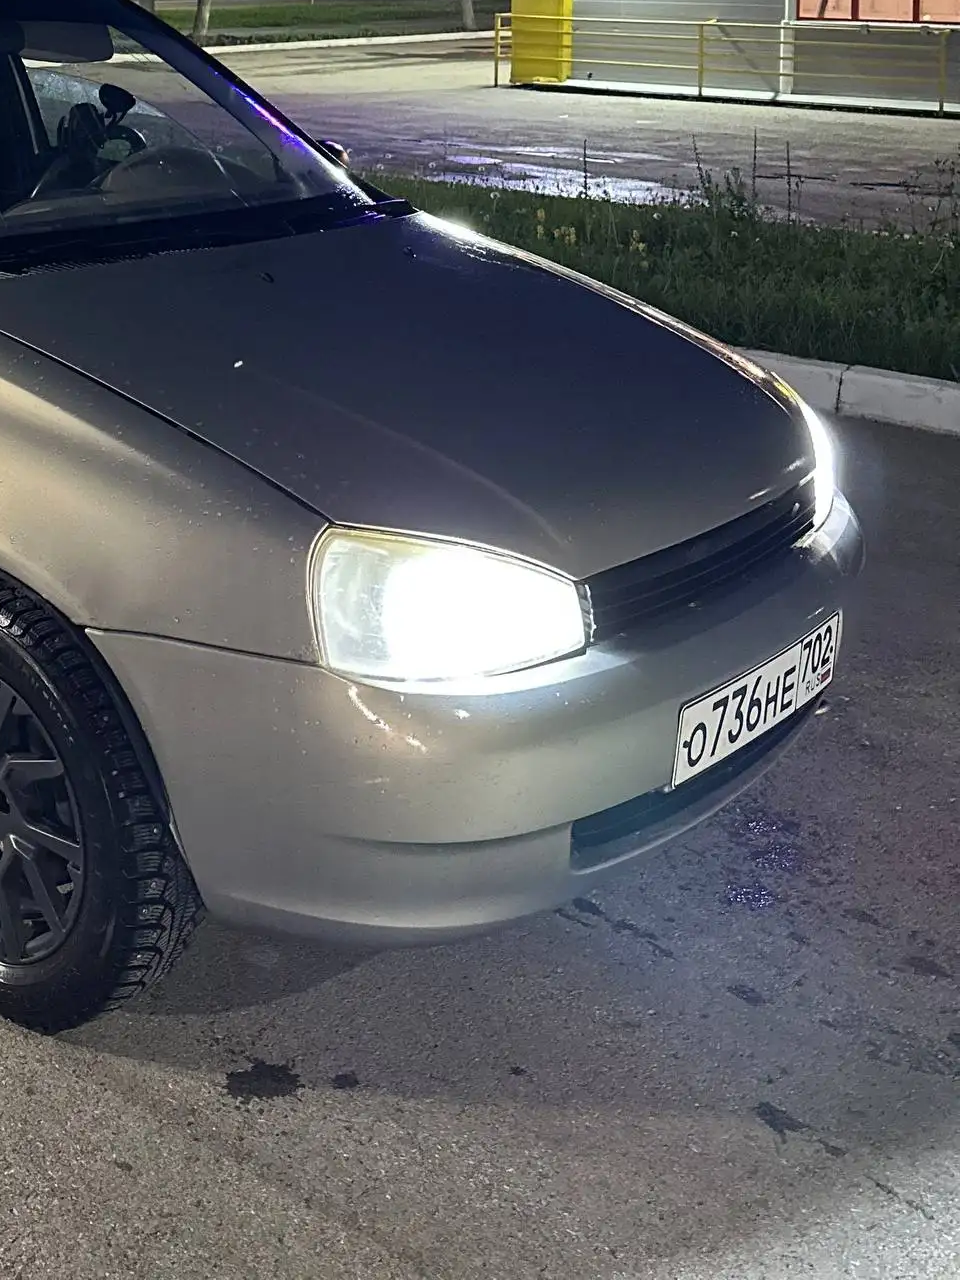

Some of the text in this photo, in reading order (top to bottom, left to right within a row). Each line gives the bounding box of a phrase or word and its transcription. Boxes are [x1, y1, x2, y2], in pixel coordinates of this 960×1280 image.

[687, 625, 833, 768] О736НЕ 702
[805, 672, 822, 694] RUS
